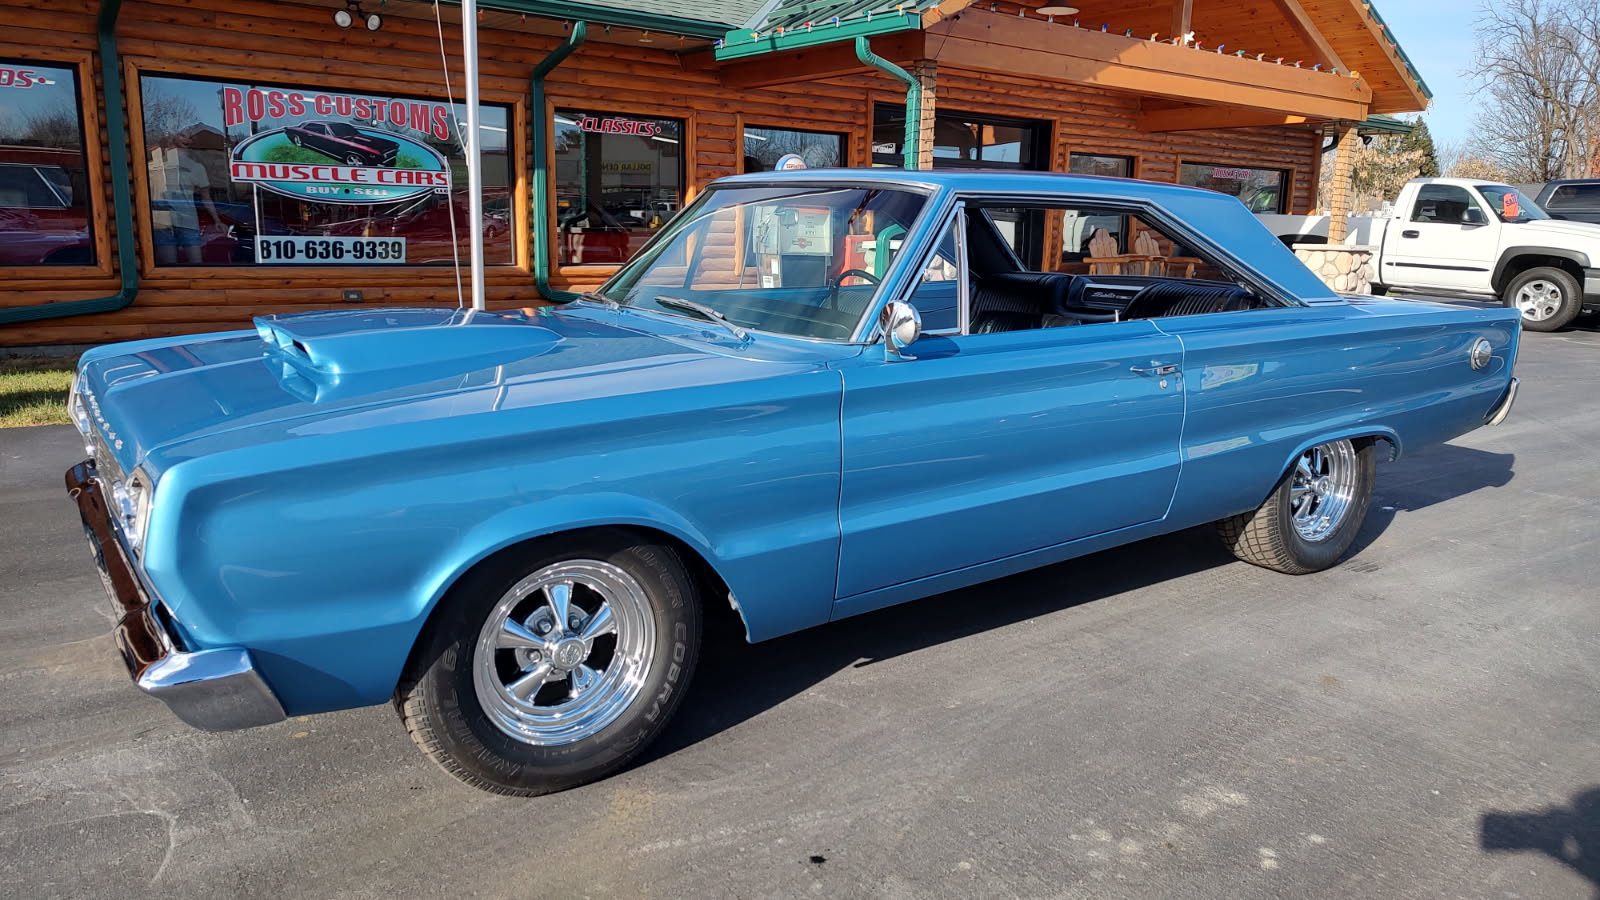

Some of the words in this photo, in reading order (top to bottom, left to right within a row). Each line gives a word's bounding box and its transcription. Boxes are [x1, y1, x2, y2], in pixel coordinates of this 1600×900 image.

[223, 87, 305, 127] ROSS
[314, 94, 449, 140] CUSTOMS
[582, 118, 655, 136] CLASSICS
[232, 163, 368, 183] MUSCLE
[377, 170, 448, 185] CARS
[305, 185, 340, 195] BUY
[353, 187, 389, 196] SELL
[260, 240, 403, 260] 810-636-9339
[645, 622, 687, 722] COBRA
